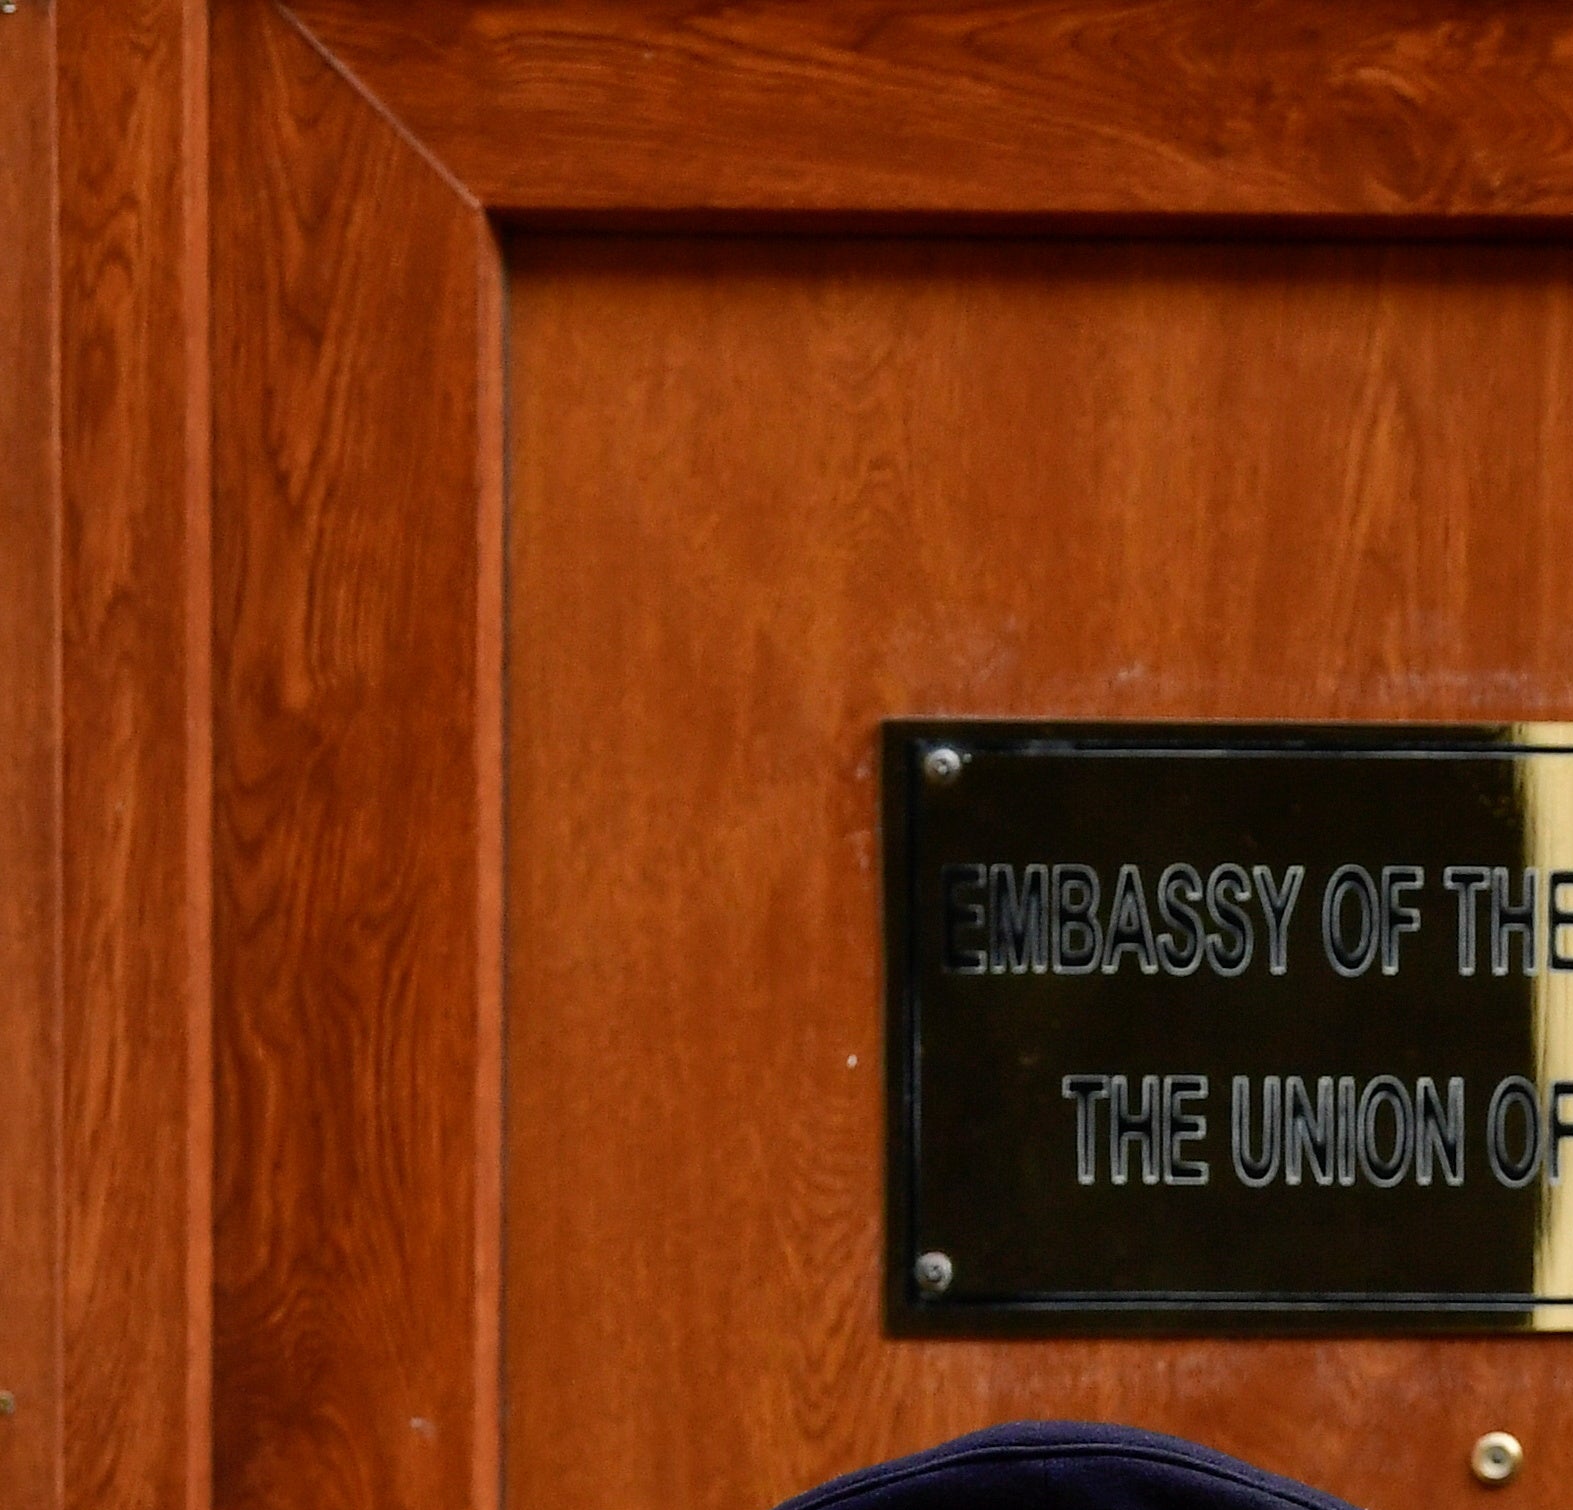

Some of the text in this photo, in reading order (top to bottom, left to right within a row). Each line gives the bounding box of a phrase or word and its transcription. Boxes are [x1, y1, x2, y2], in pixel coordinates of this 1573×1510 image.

[940, 862, 1306, 977] EMBASSY
[1321, 865, 1424, 977] OF
[1063, 1073, 1209, 1187] THE
[1229, 1073, 1466, 1189] UNION
